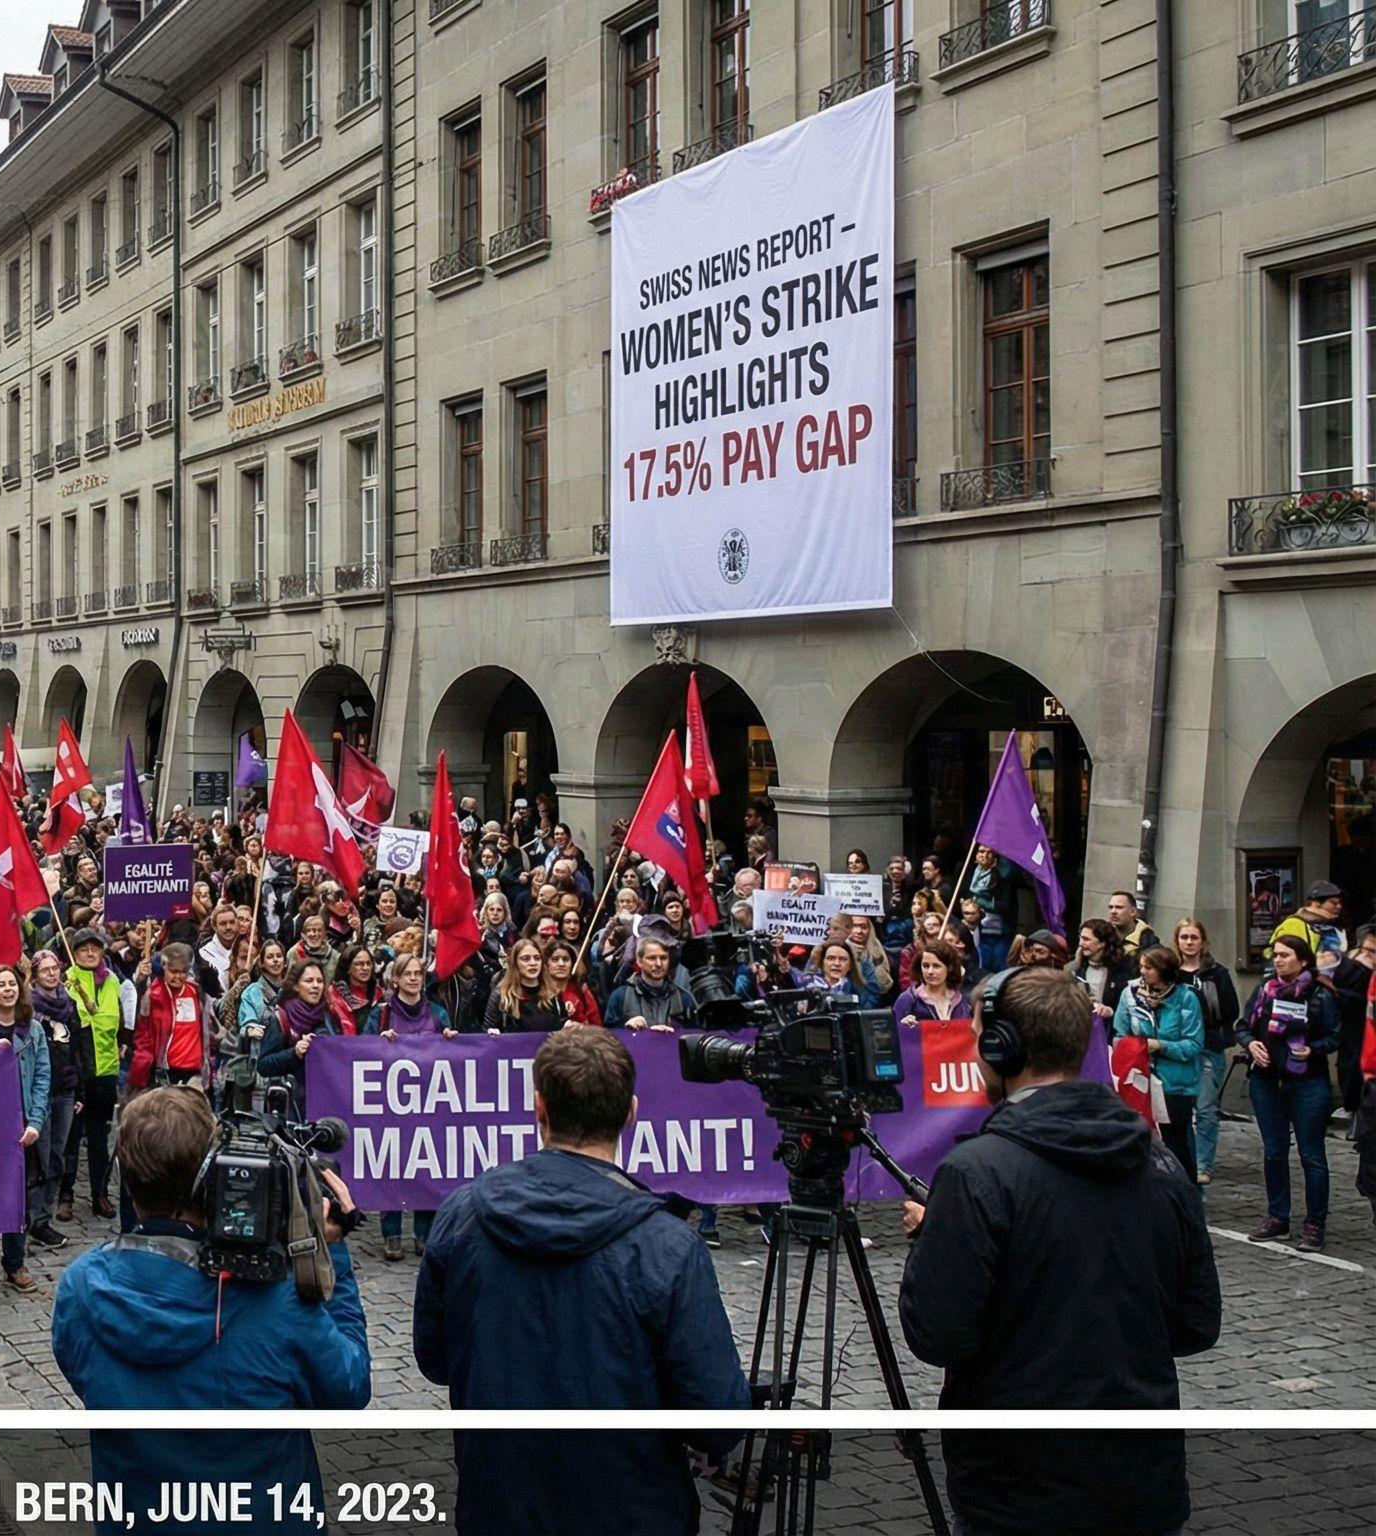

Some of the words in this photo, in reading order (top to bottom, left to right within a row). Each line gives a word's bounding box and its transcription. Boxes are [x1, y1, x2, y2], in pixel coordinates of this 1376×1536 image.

[639, 263, 693, 310] SWISS
[698, 244, 751, 292] NEWS
[757, 213, 836, 273] REPORT
[620, 293, 752, 376] WOMEN’S
[762, 253, 879, 338] STRIKE
[654, 341, 830, 430] HIGHLIGHTS
[623, 435, 712, 503] 17.5%
[722, 421, 784, 487] PAY
[795, 403, 873, 474] GAP
[108, 879, 188, 895] MAINTENANT!
[125, 860, 173, 878] EGALITÉ
[352, 1058, 536, 1115] EGALIT
[930, 1062, 987, 1093] JUN
[352, 1119, 755, 1179] MAINTANT!
